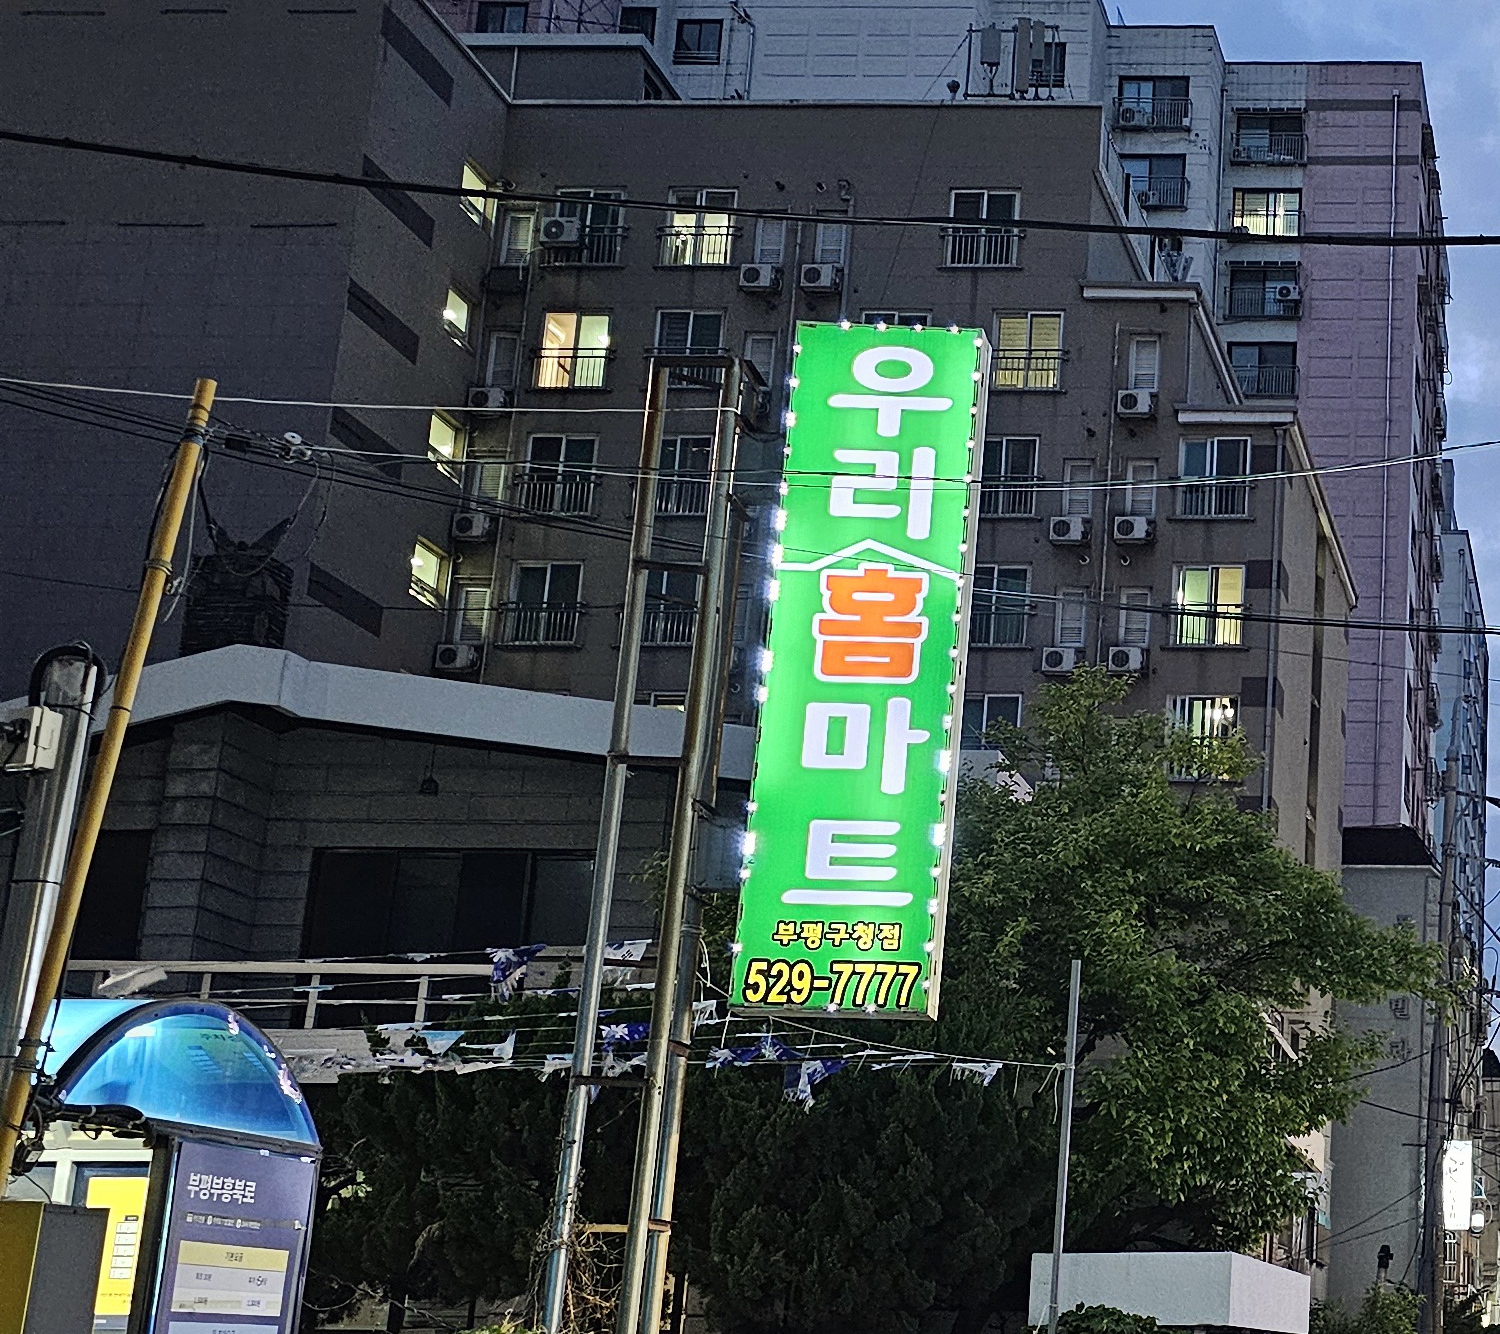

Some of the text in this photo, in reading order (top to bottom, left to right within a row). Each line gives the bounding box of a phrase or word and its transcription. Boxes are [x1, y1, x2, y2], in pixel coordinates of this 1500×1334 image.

[772, 920, 904, 950] 부평구청점
[743, 961, 922, 1008] 529-7777
[187, 1173, 257, 1204] 부평부흥북로
